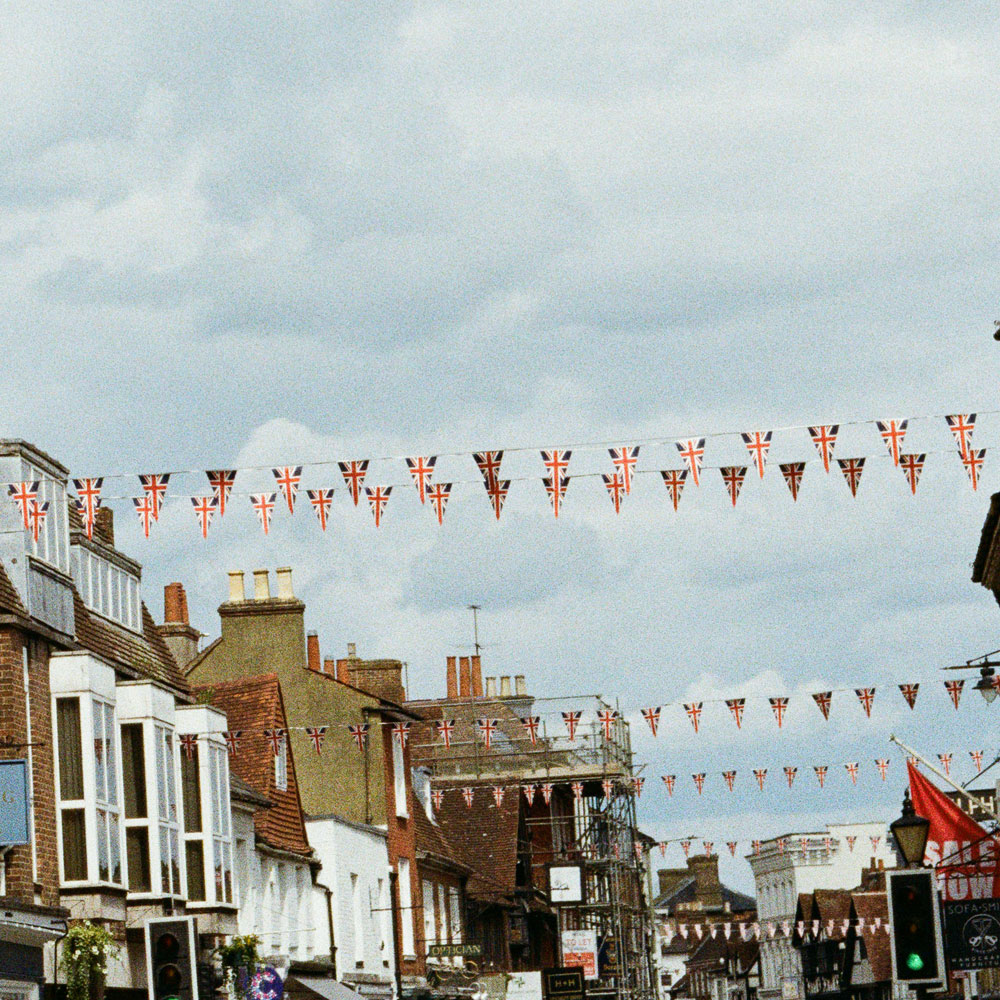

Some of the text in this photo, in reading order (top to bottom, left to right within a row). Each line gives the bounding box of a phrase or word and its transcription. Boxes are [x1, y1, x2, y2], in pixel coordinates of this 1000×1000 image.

[923, 840, 996, 868] SALE
[578, 938, 592, 946] LET
[432, 945, 481, 954] OPTICIAN
